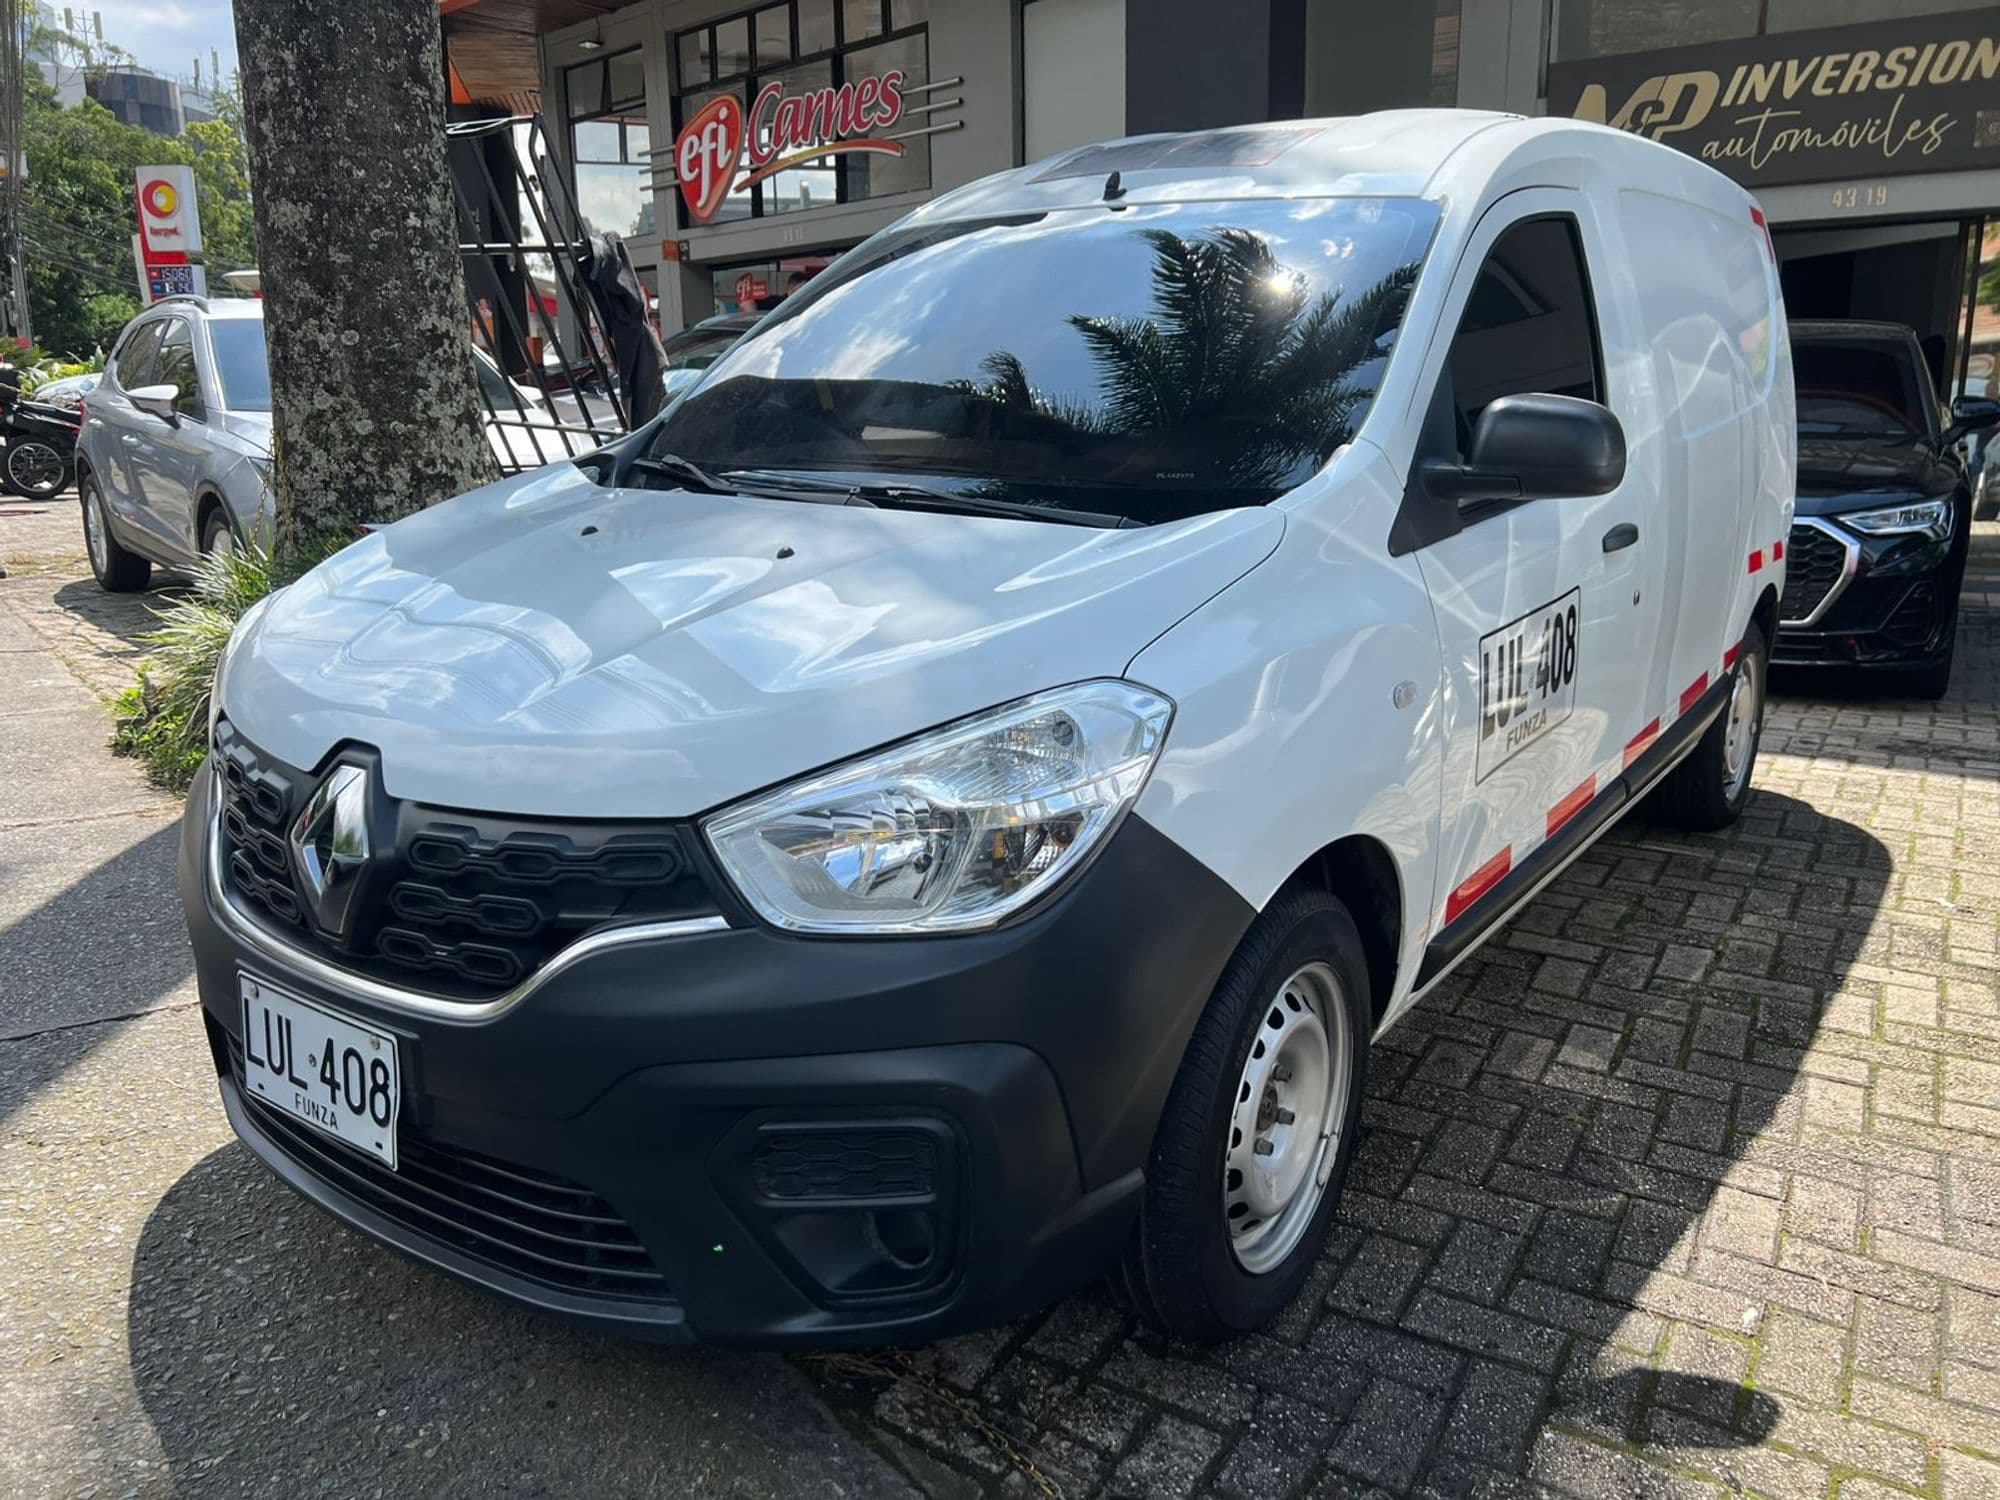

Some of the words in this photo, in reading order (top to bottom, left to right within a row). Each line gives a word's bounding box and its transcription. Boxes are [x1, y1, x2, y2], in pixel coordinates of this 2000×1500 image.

[1719, 37, 2000, 107] INVERSION
[680, 105, 732, 209] efi
[749, 69, 904, 166] Carnes
[1702, 93, 1958, 170] automóviles
[1481, 634, 1528, 741] LUL
[1535, 603, 1577, 700] 408
[1506, 707, 1548, 752] FUNZA
[243, 997, 308, 1090] LUL
[320, 1036, 392, 1128] 408
[294, 1092, 339, 1131] FUNZA
